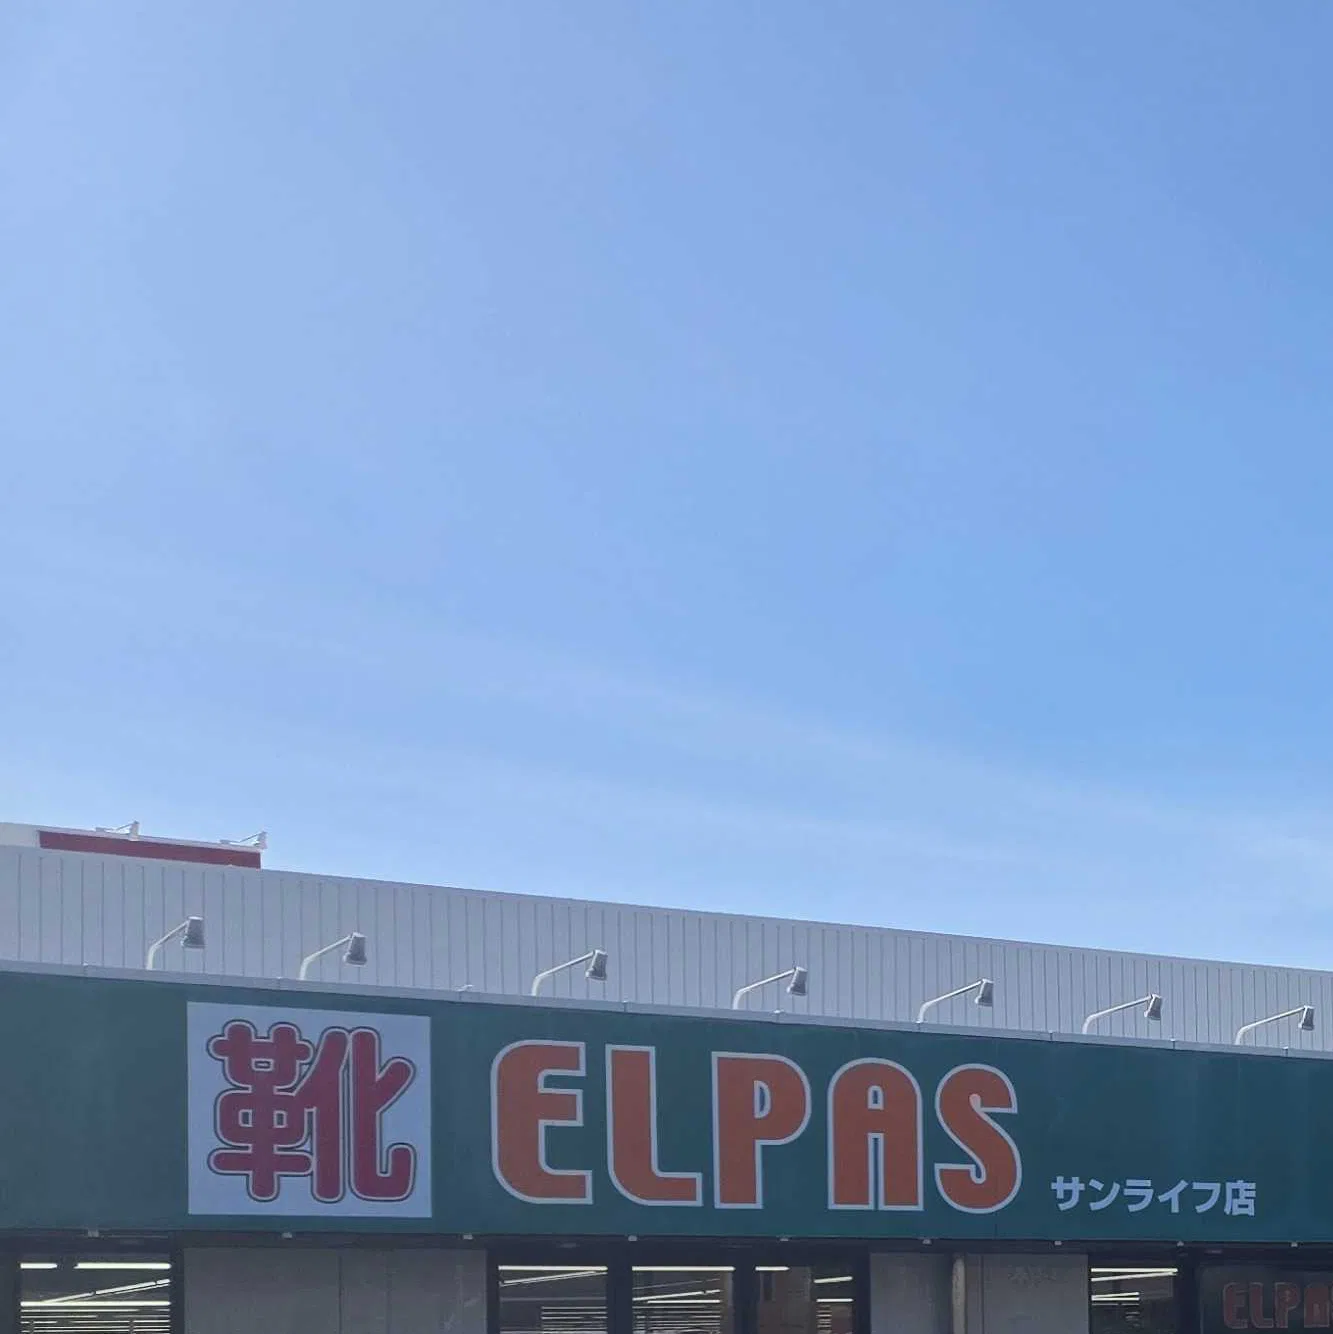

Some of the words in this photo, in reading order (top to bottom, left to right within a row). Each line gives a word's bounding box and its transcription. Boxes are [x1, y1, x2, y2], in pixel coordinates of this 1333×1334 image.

[206, 1019, 417, 1204] 靴
[490, 1040, 1022, 1214] ELPAS
[1051, 1176, 1257, 1216] サンライフ店
